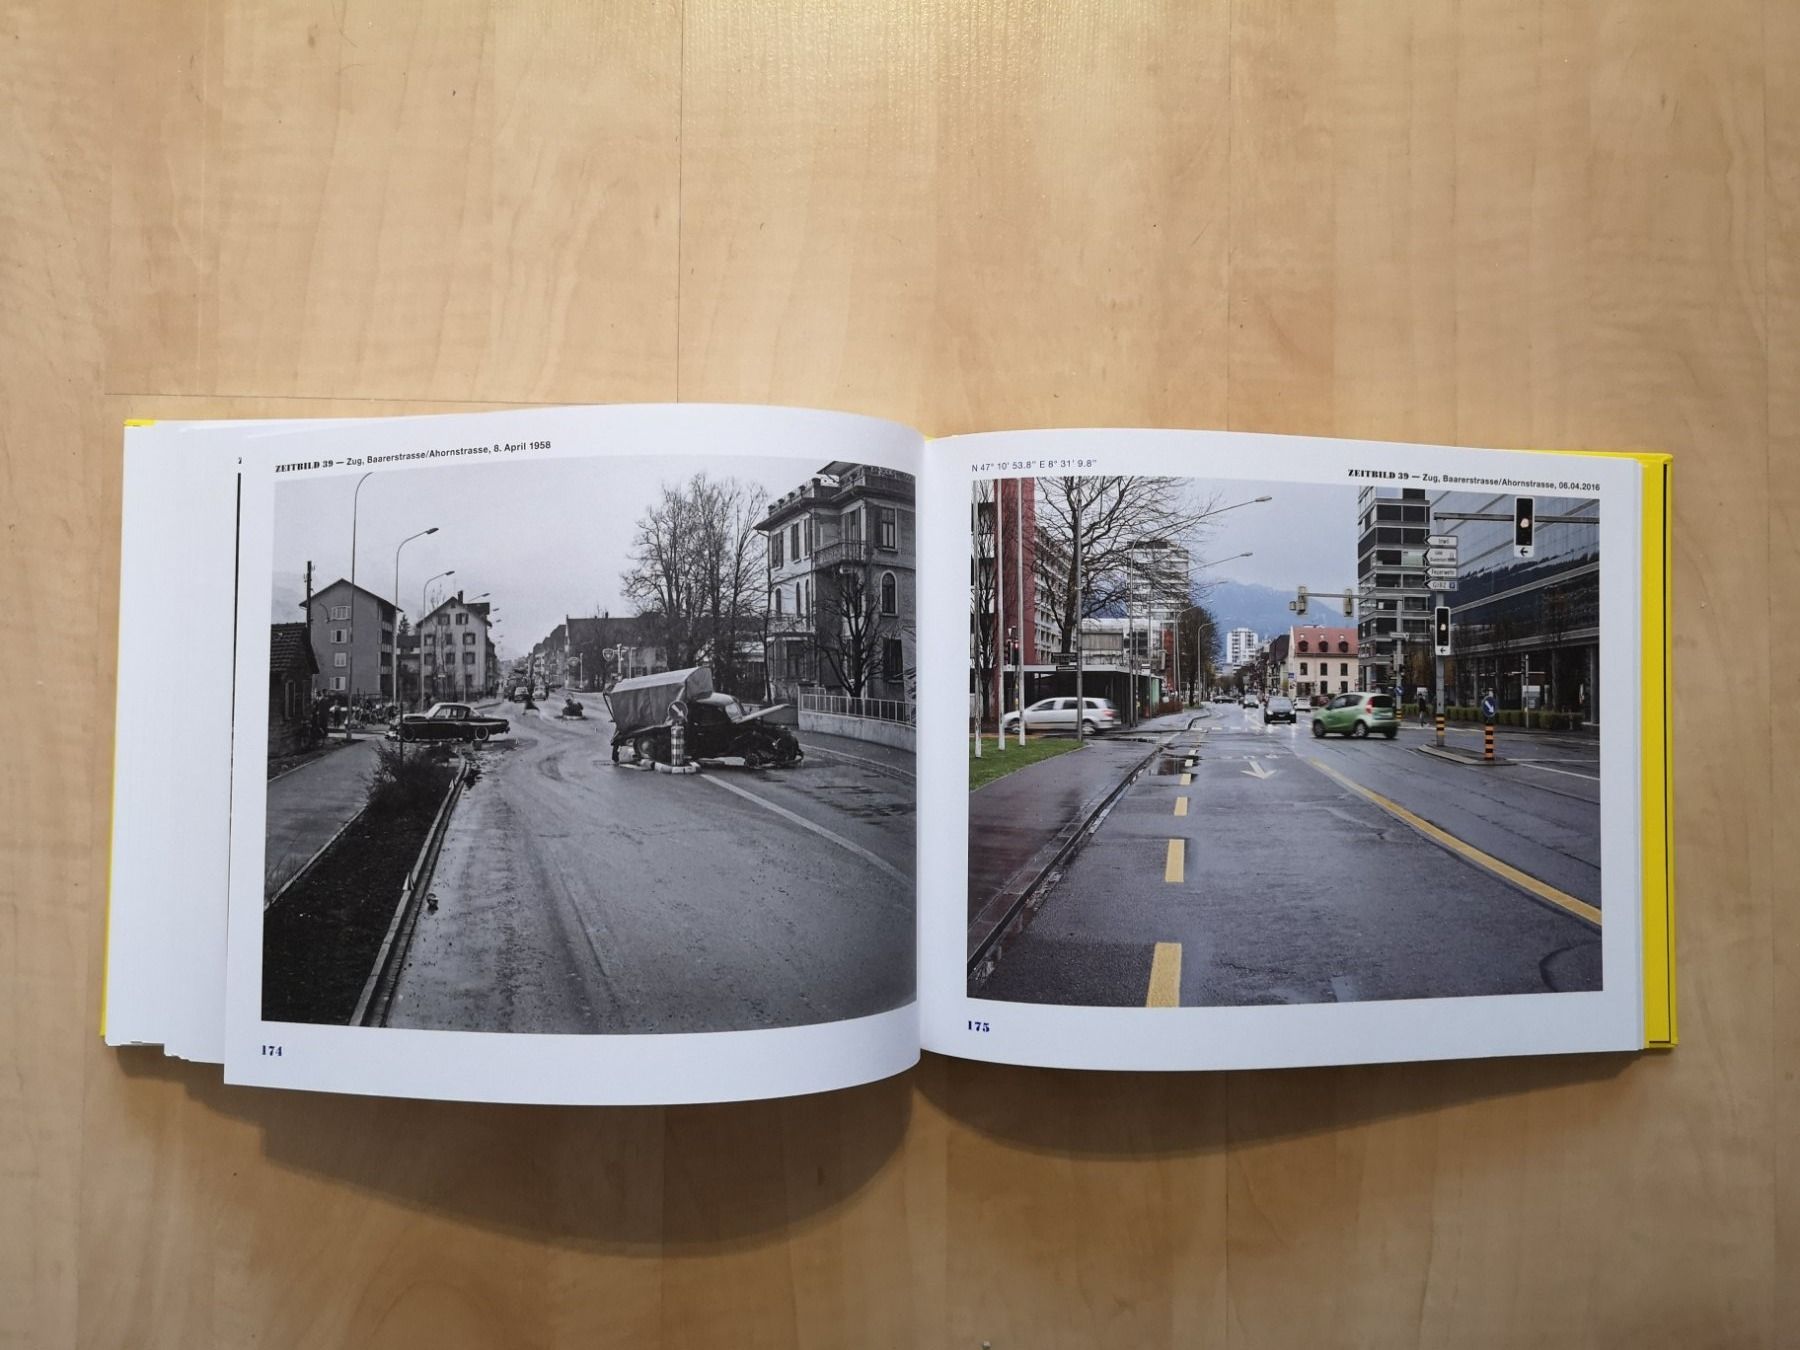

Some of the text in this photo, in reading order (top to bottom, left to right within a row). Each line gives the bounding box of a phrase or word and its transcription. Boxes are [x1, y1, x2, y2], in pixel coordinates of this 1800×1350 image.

[275, 461, 320, 473] ZEITBILD
[322, 459, 334, 468] 39
[346, 457, 365, 467] Zug,
[367, 446, 491, 464] Baarerstrasse/Ahornstrasse,
[494, 444, 502, 453] 8.
[504, 442, 526, 453] April
[529, 440, 551, 450] 1958
[971, 463, 978, 472] N
[980, 463, 995, 471] 47°
[1039, 460, 1045, 469] E
[1348, 469, 1396, 479] ZEITBILD
[1398, 472, 1409, 480] 39
[1422, 473, 1441, 483] Zug,
[1443, 475, 1557, 490] Baarerstrasse/Ahornstrasse,
[1558, 481, 1601, 491] 06.04.2016
[968, 1020, 990, 1032] 175
[262, 1044, 282, 1057] 174
